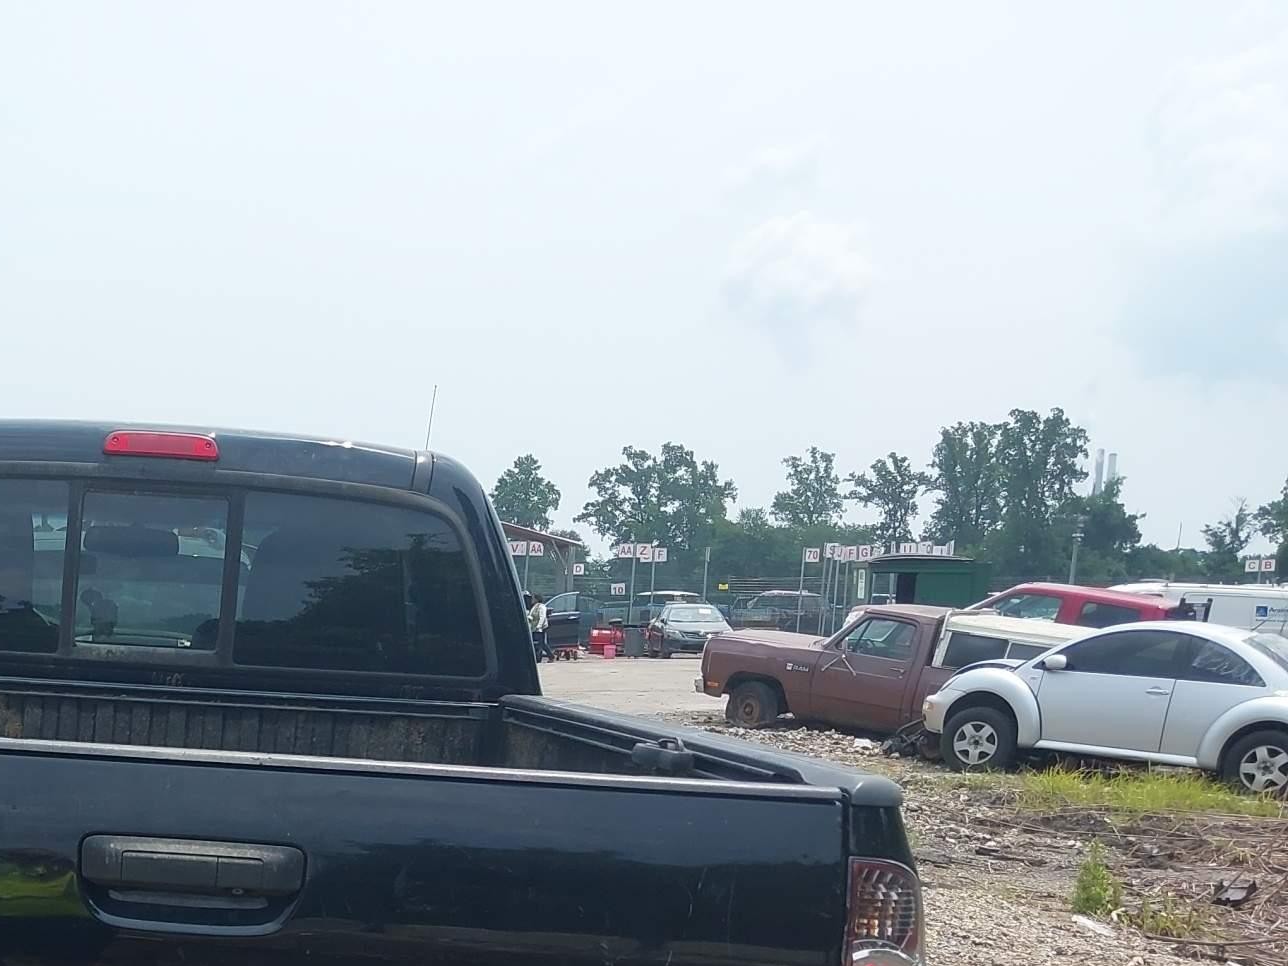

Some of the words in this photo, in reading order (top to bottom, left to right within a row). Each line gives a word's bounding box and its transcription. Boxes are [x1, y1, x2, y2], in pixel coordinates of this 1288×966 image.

[620, 546, 632, 555] AA
[640, 546, 648, 555] Z
[657, 550, 664, 560] F
[807, 550, 818, 560] 70
[848, 548, 854, 557] F
[861, 548, 868, 557] G
[575, 565, 581, 573] D
[1248, 561, 1256, 570] C
[1264, 561, 1272, 570] B
[613, 586, 624, 594] 10
